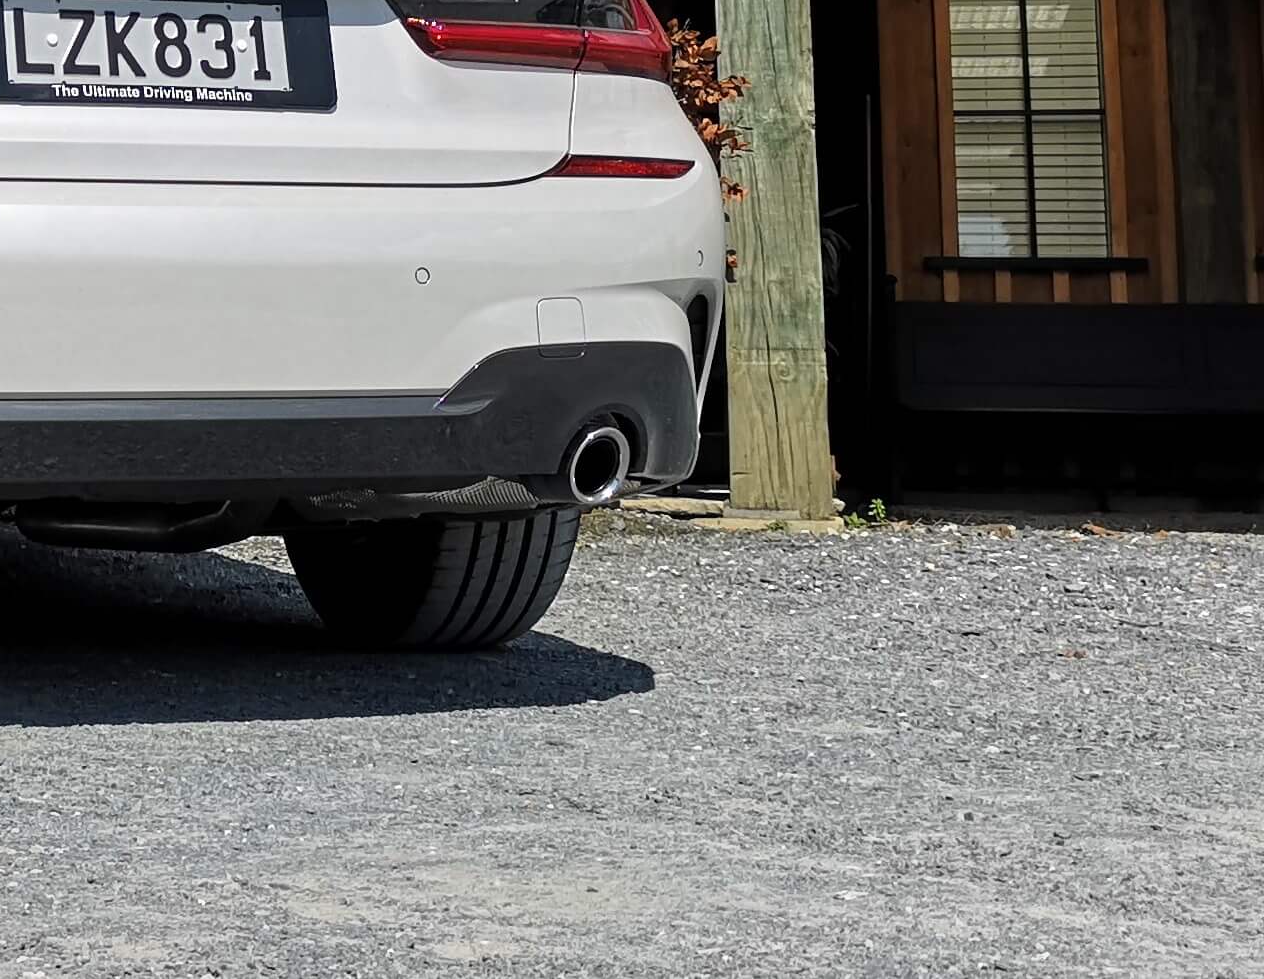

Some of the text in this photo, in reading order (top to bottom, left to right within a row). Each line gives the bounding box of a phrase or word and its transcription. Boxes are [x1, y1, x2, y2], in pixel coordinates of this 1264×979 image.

[12, 7, 272, 82] LZK831
[51, 84, 253, 102] The Ultimate Driving Machine
